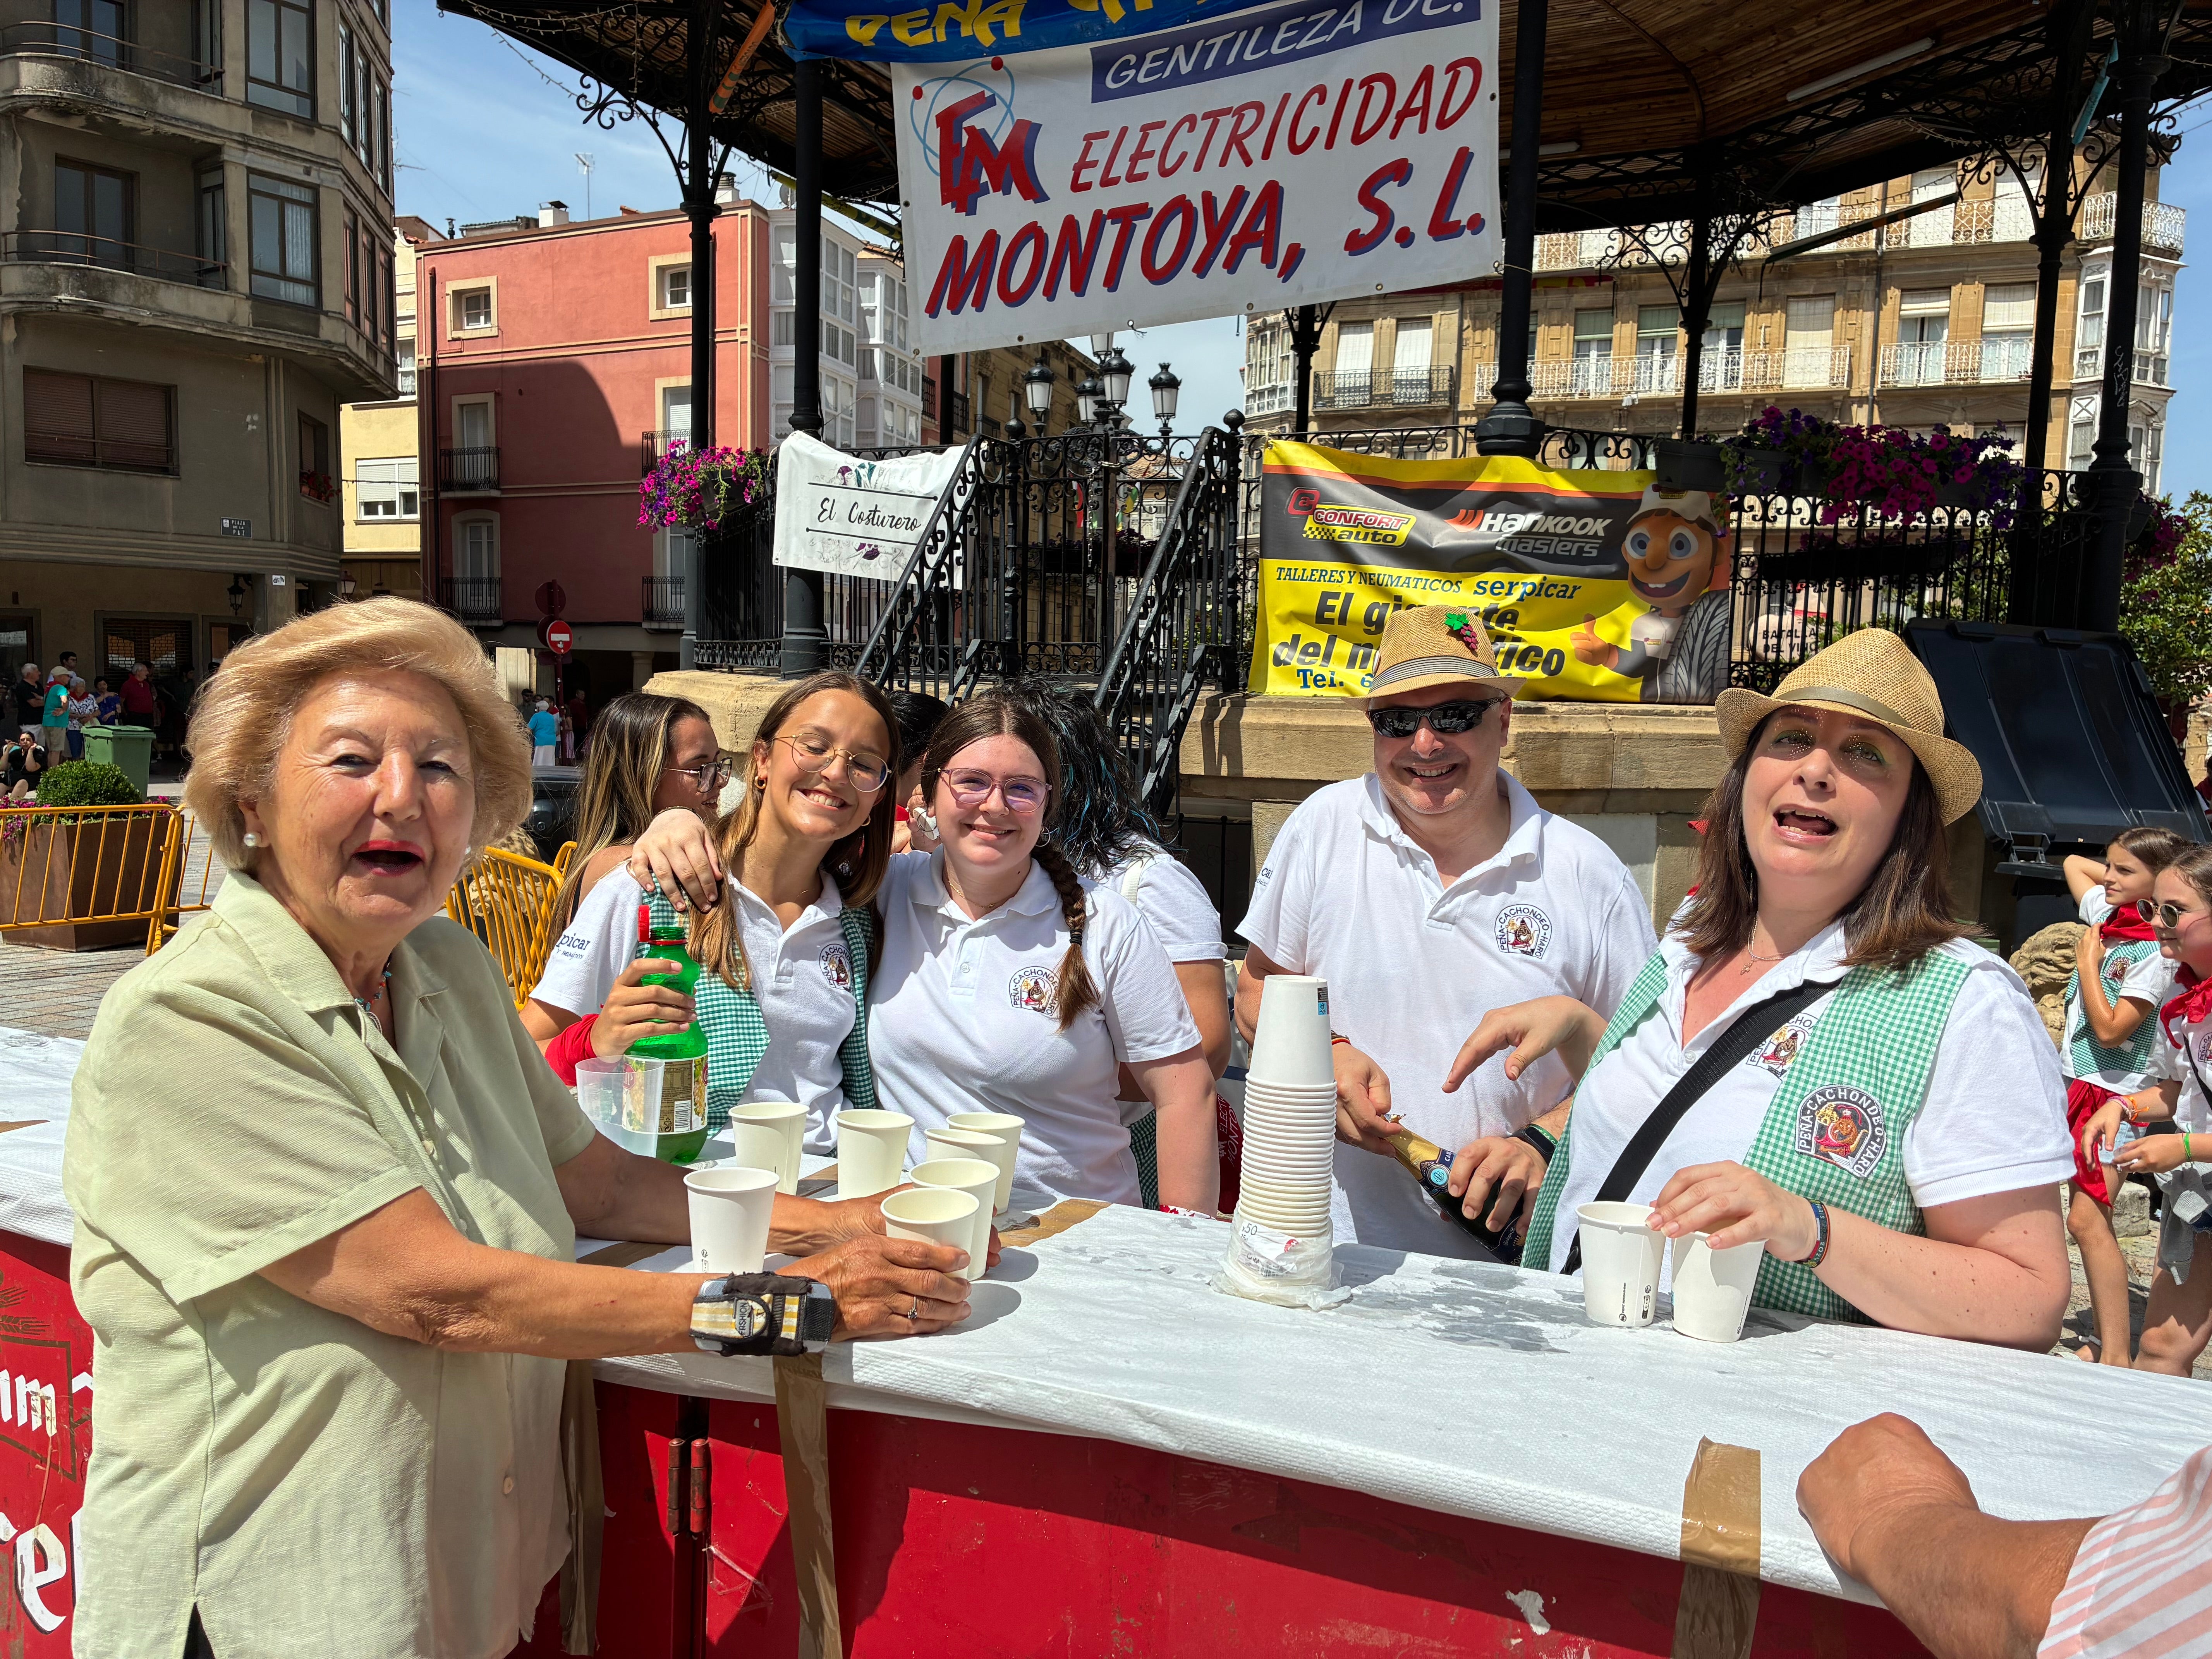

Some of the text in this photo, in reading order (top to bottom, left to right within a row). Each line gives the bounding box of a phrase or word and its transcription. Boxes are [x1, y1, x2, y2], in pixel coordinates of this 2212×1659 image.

[1105, 0, 1363, 90] GENTILEZA
[1070, 57, 1483, 193] ELECTRICIDAD
[924, 179, 1305, 319] MONTOYA,
[817, 497, 921, 531] El Costurero
[1314, 509, 1409, 530] CONFORT
[1337, 529, 1398, 544] auto
[1276, 567, 1582, 601] TALLERES Y NEUMATICOS serpicar
[1315, 591, 1355, 626] El
[1272, 634, 1338, 668] del
[1296, 668, 1344, 689] Tel.
[555, 933, 591, 950] picar
[1217, 1095, 1228, 1134] ELECTR
[1227, 1108, 1239, 1168] MONTO
[1242, 1223, 1258, 1235] x50
[738, 1302, 748, 1335] FASHION
